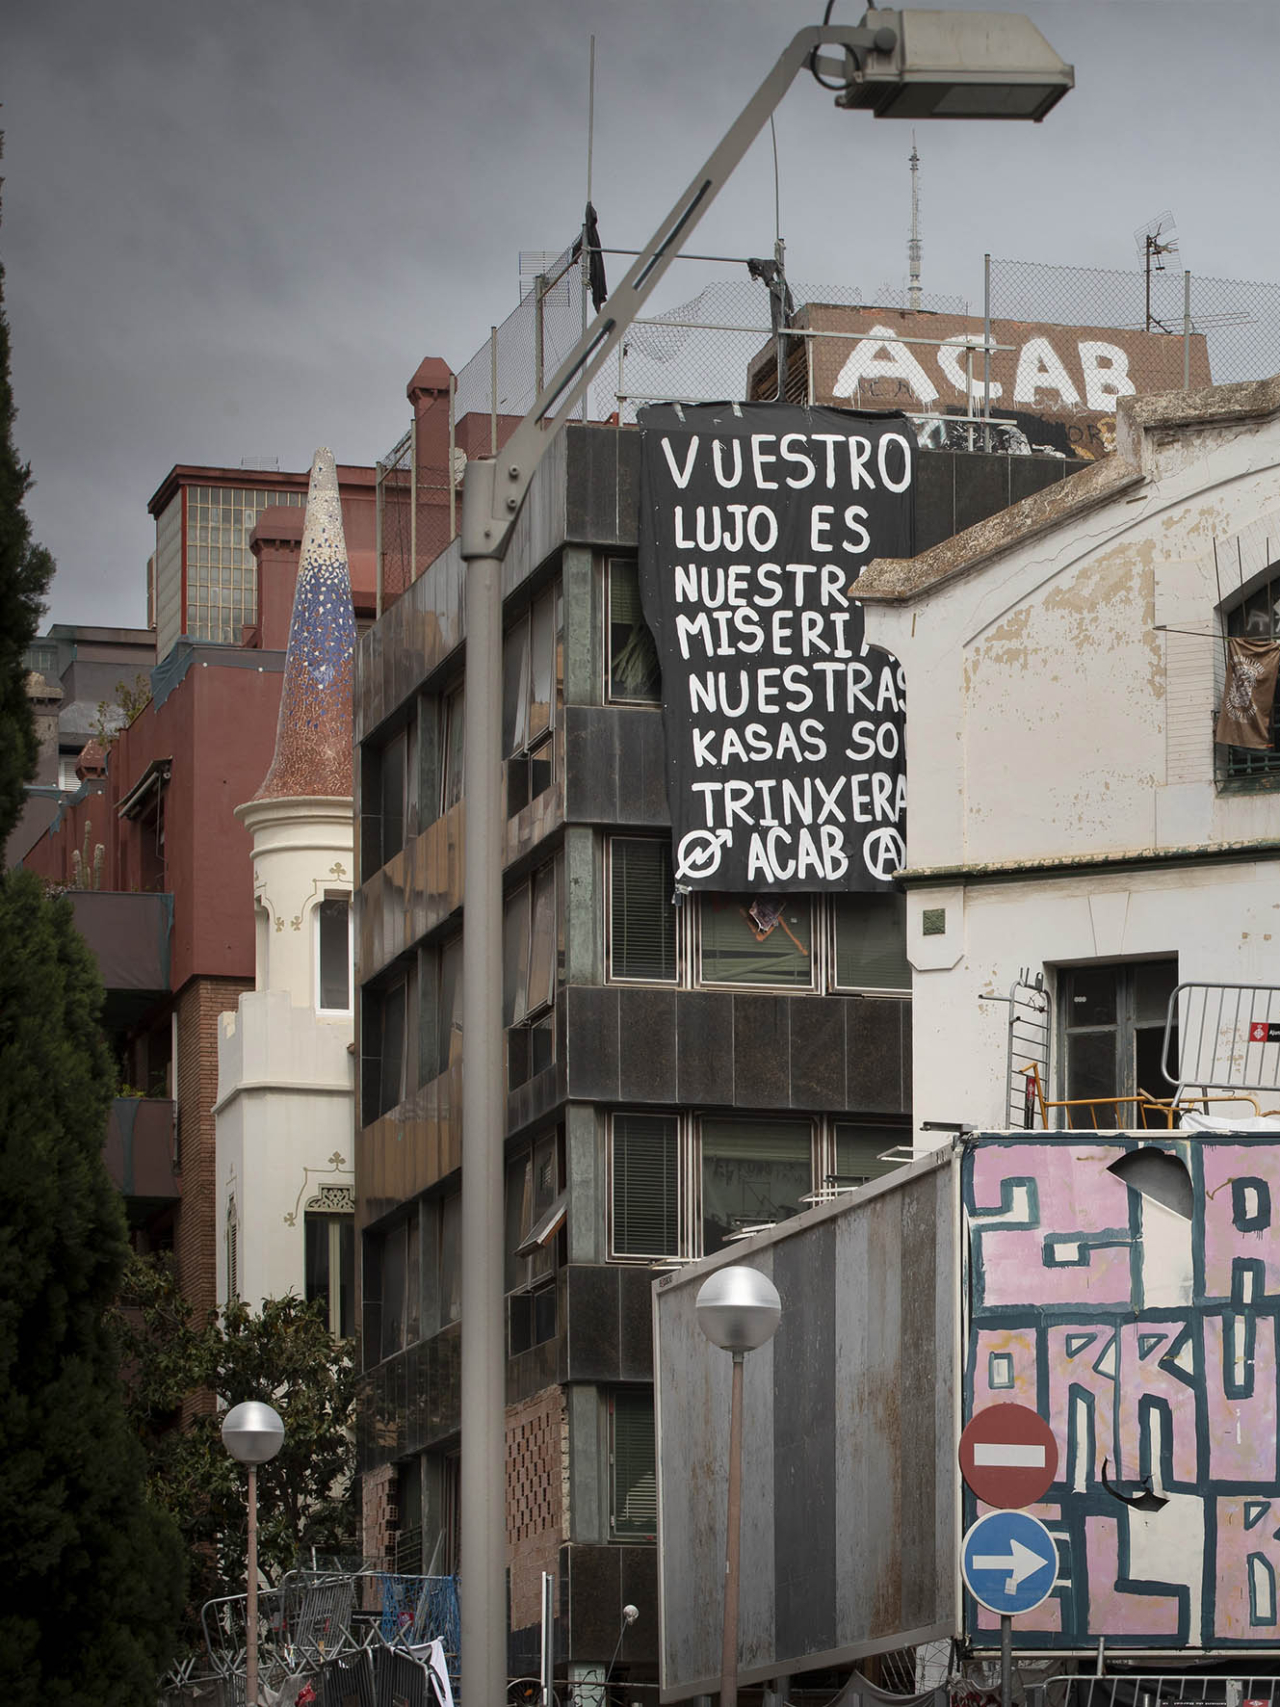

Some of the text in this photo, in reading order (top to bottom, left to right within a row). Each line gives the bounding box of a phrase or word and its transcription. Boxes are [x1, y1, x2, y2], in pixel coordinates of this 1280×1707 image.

[832, 325, 1137, 413] ACAB
[661, 433, 911, 493] VUESTRO
[675, 505, 870, 553] LUJO ES
[675, 563, 867, 608] NUESTR
[675, 607, 895, 662] MISERI
[692, 718, 907, 767] KASAS SO
[748, 824, 849, 883] ACAB
[966, 1140, 1147, 1316] 2
